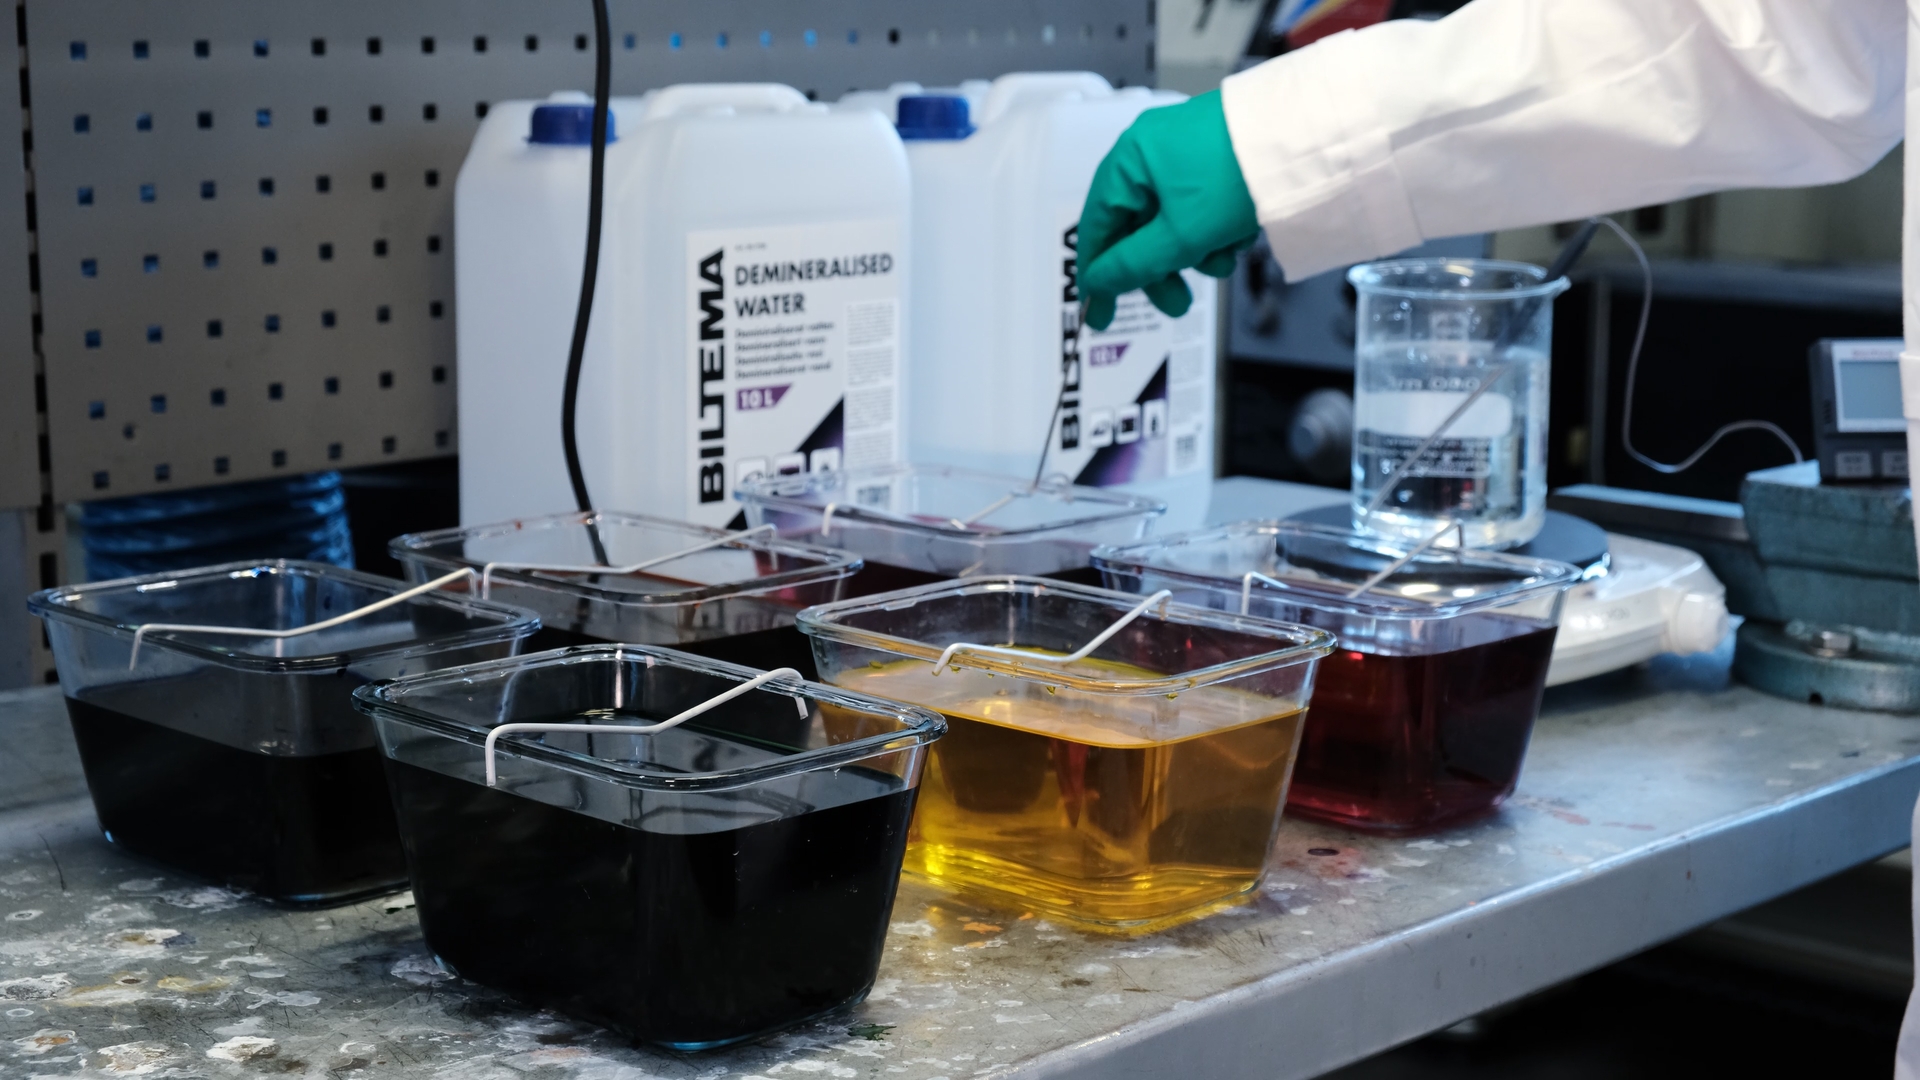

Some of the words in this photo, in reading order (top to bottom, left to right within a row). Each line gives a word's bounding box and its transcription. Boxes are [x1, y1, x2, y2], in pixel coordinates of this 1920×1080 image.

[735, 253, 894, 286] DEMINERALISED
[734, 292, 806, 318] WATER
[699, 248, 724, 503] BILTEMA
[740, 388, 763, 409] 10
[764, 387, 775, 407] L
